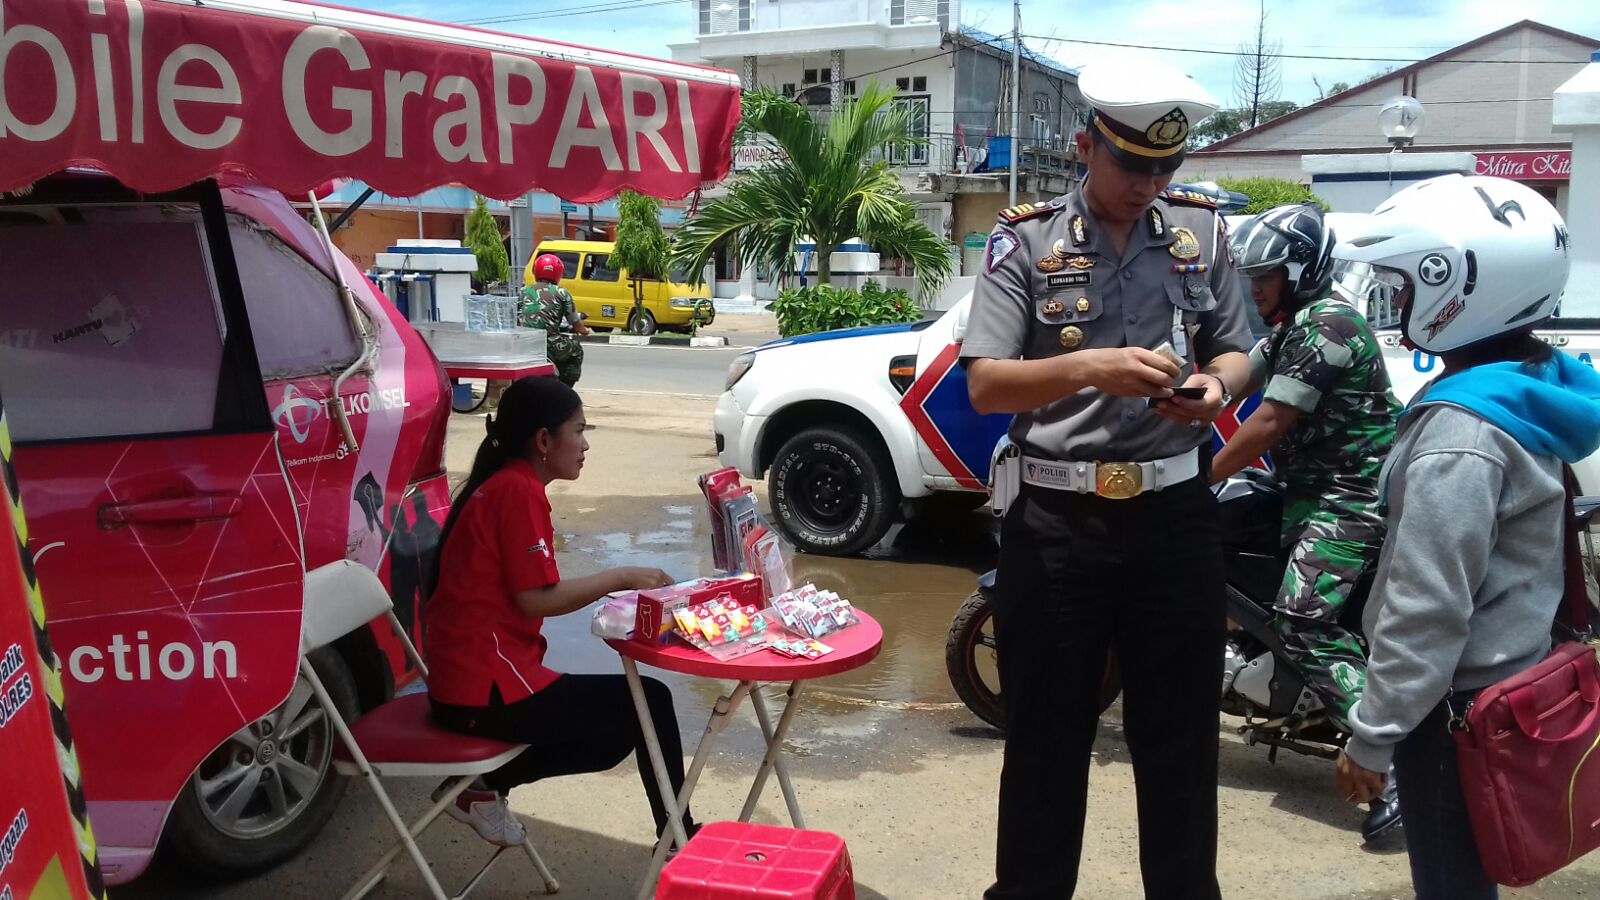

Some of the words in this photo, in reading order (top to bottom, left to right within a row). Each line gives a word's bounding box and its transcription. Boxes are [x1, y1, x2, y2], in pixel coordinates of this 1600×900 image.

[282, 25, 701, 173] GraPARI
[1476, 155, 1527, 175] Mitra
[52, 318, 103, 344] KARTU
[320, 388, 410, 419] TLKOMSEL
[286, 457, 308, 468] Telkom
[1040, 467, 1067, 478] POLISI
